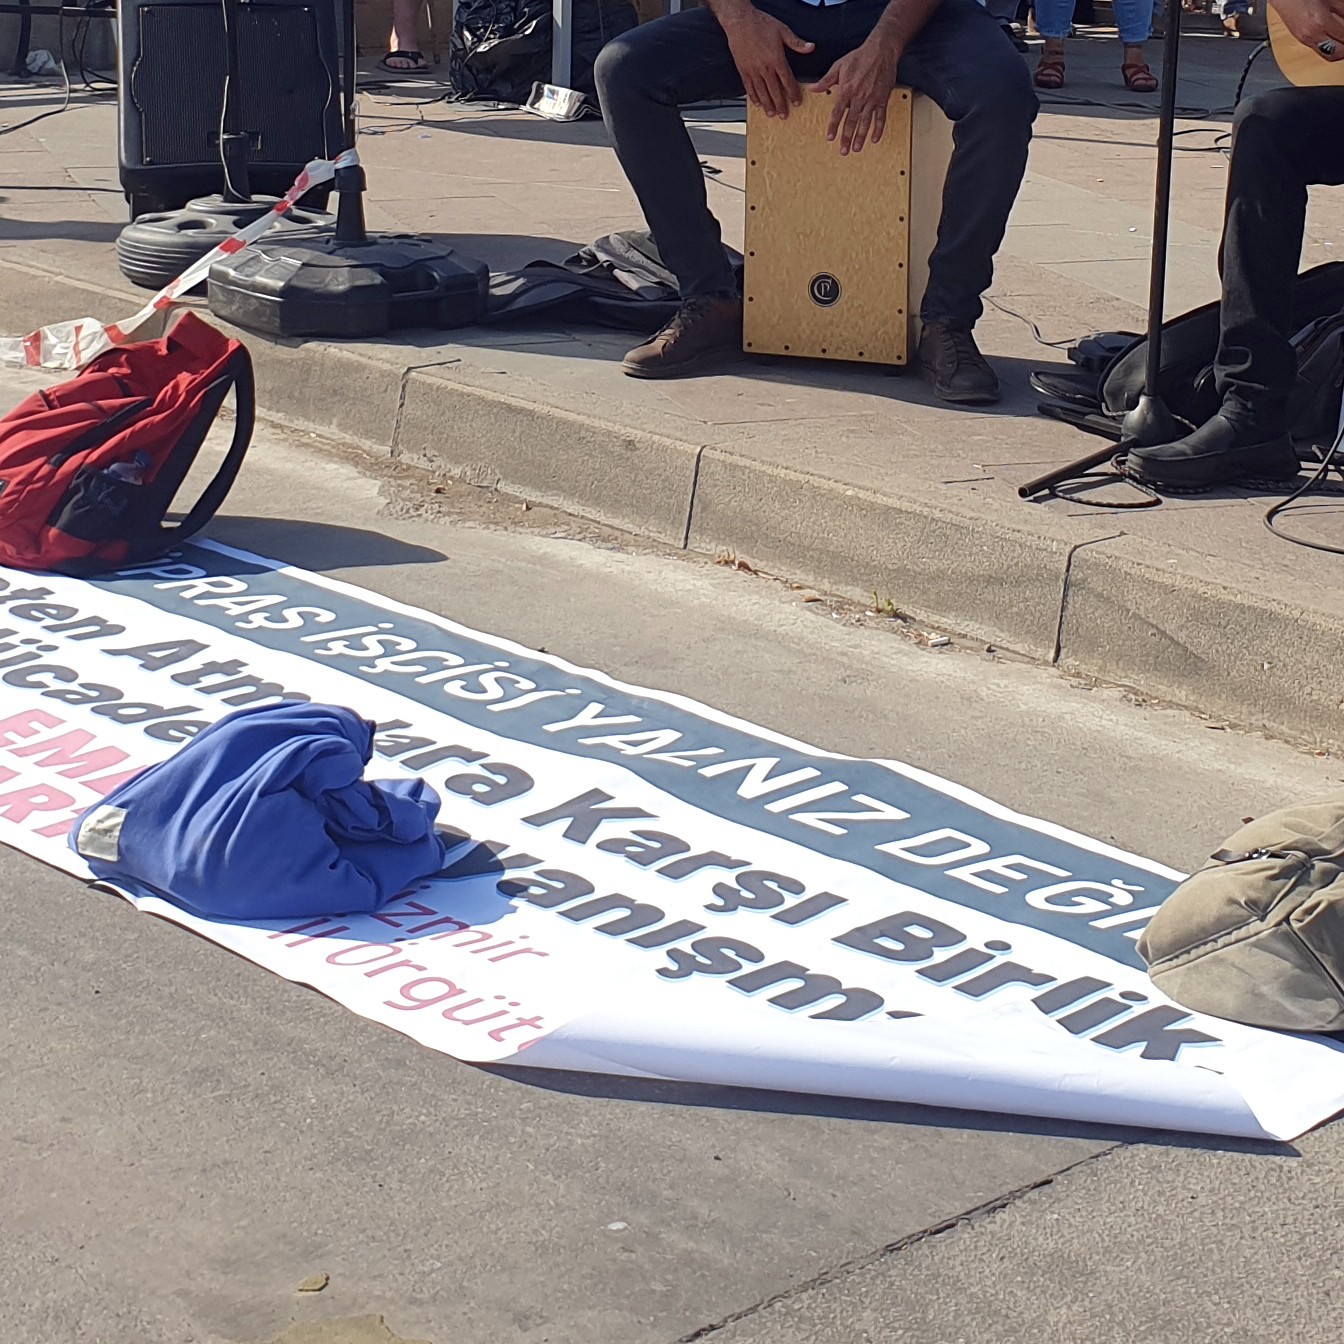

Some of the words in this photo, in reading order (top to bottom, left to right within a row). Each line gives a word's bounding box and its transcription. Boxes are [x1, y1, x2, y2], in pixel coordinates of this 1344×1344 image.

[300, 621, 583, 712] İŞÇİSİ
[541, 701, 912, 836] YALNIZ
[520, 787, 849, 927] Karşı
[831, 910, 1224, 1063] Birlik
